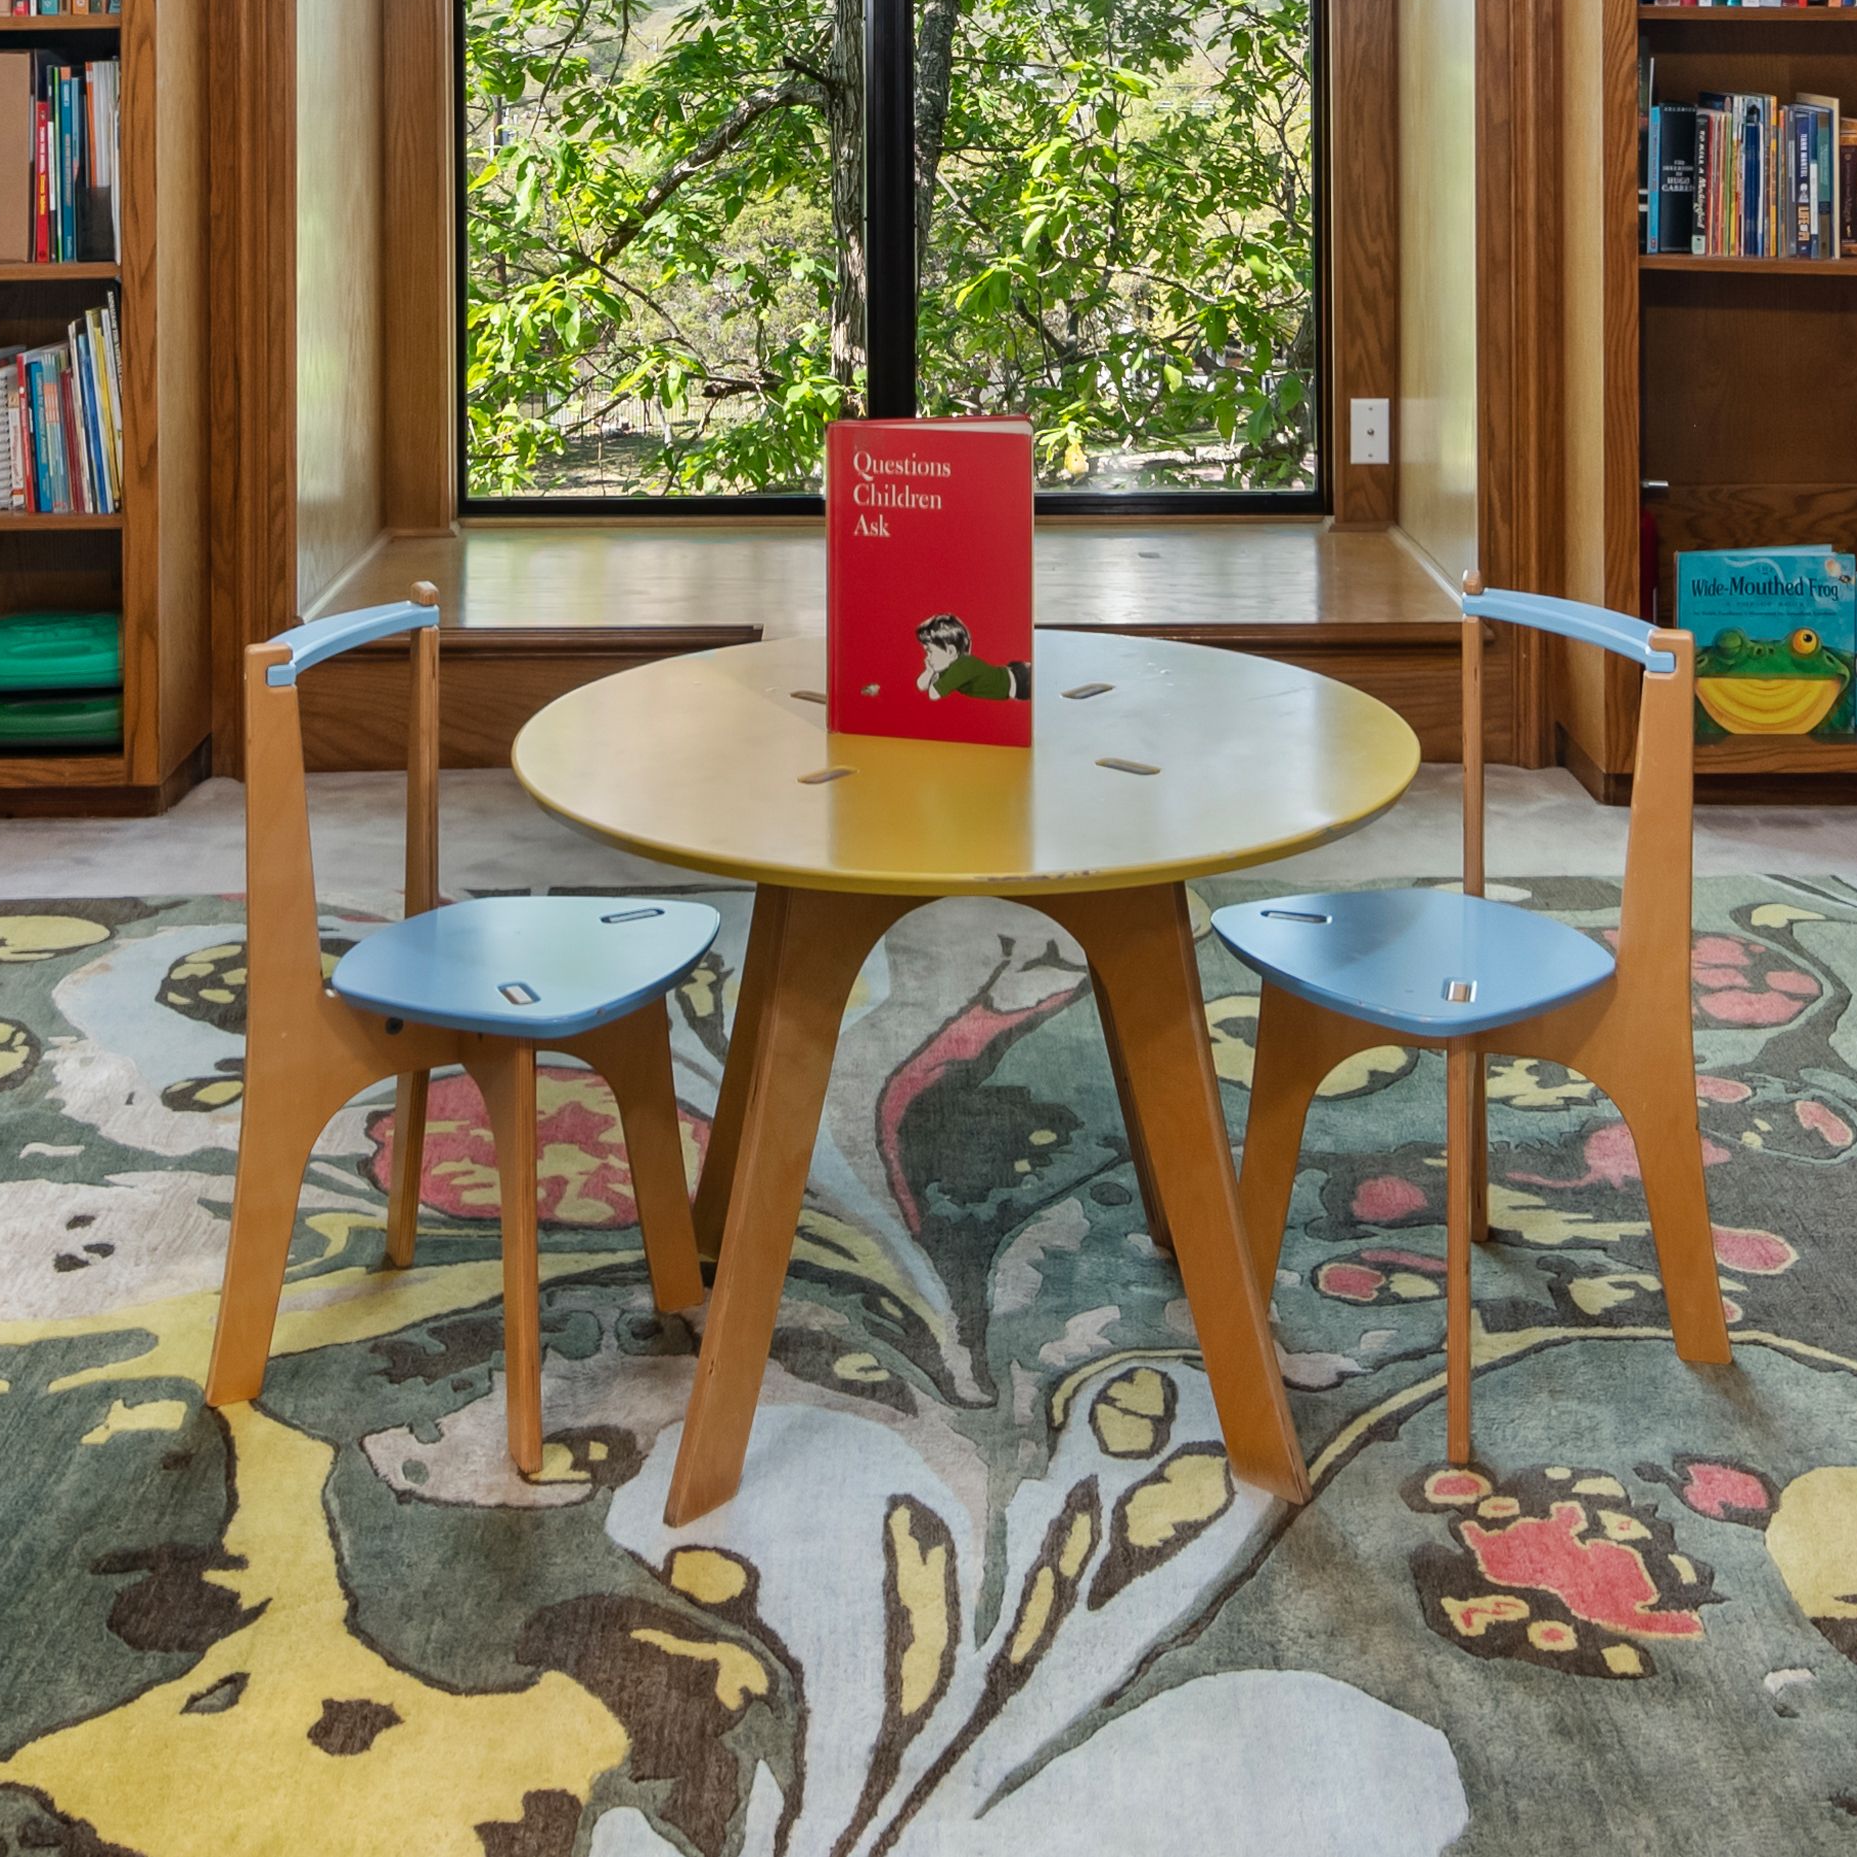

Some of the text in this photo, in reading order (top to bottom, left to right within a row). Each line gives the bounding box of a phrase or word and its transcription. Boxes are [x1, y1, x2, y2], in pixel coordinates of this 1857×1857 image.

[852, 450, 952, 481] Questions
[852, 482, 942, 511] Children
[853, 513, 890, 538] Ask
[1691, 576, 1839, 601] Wide-Mouthed Frog
